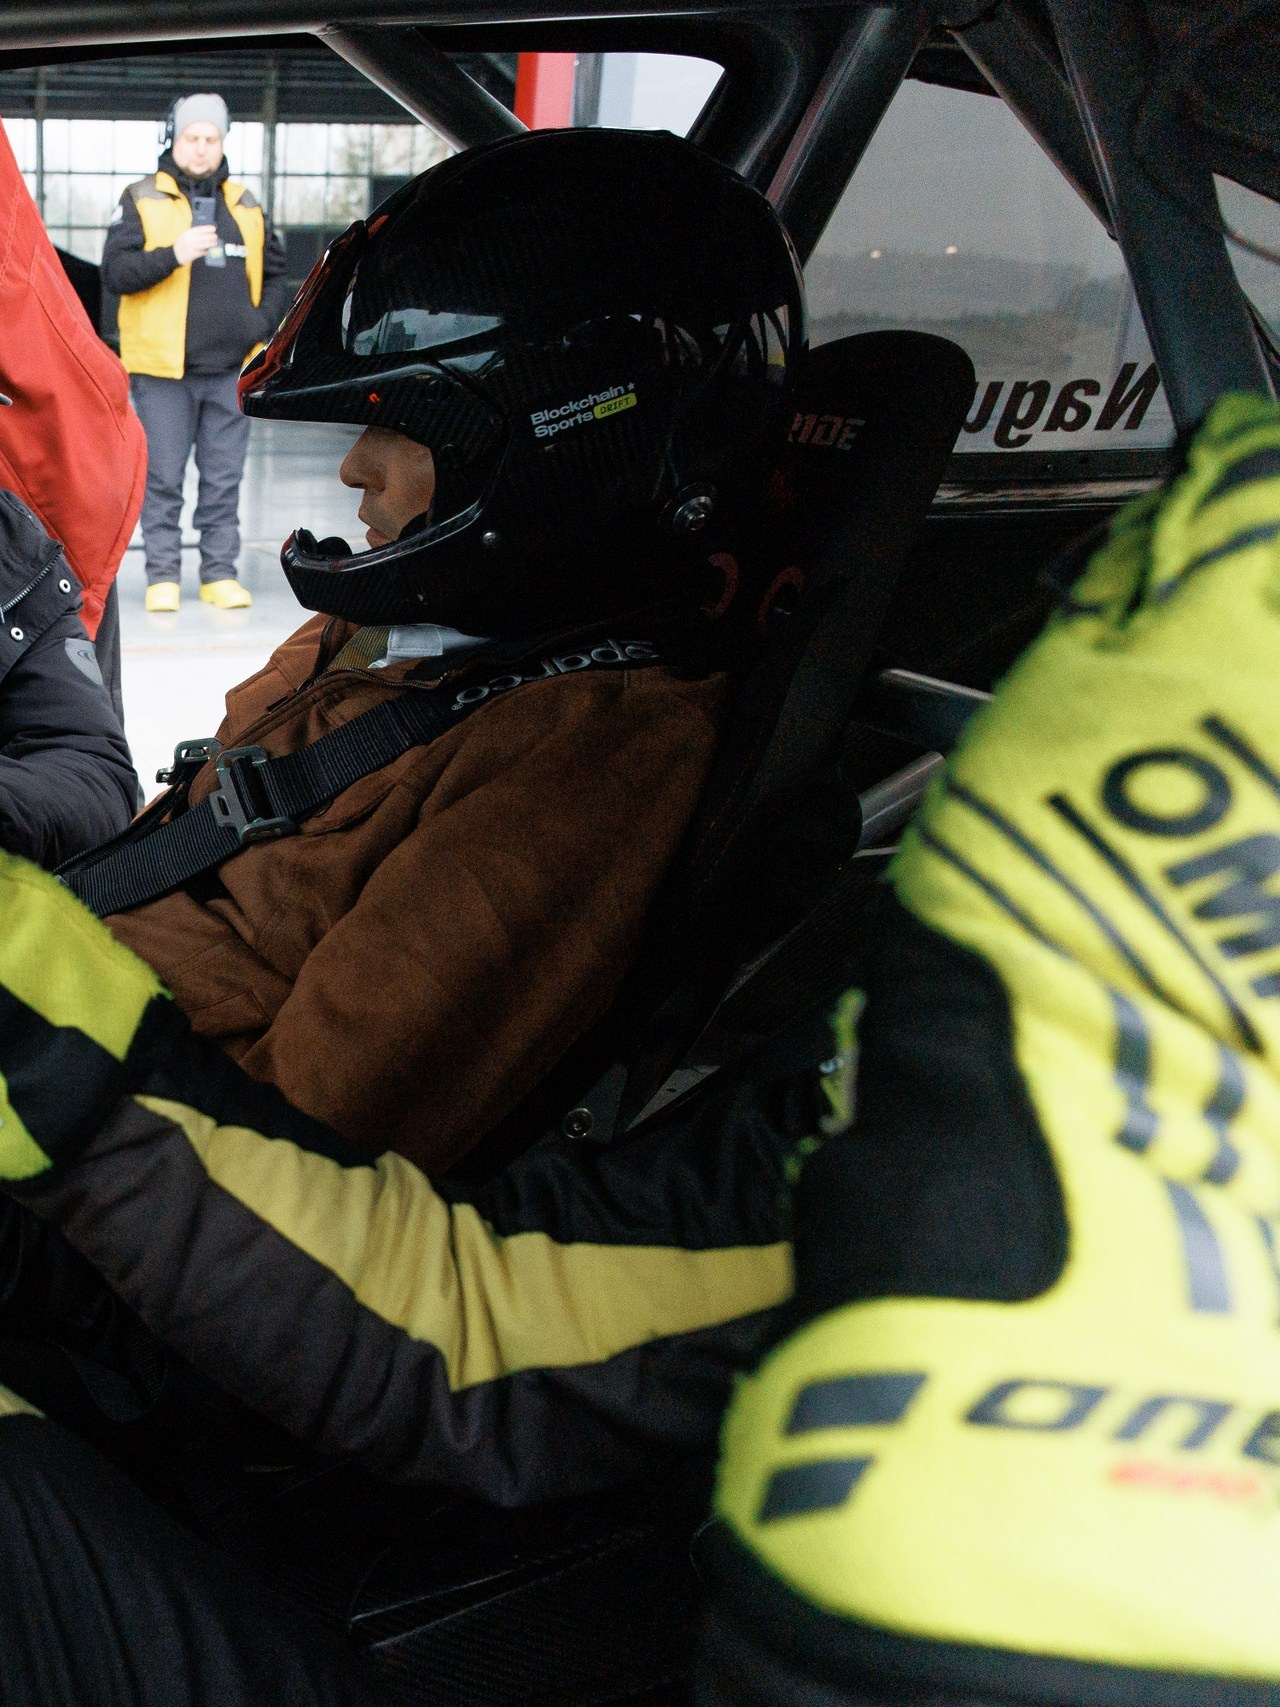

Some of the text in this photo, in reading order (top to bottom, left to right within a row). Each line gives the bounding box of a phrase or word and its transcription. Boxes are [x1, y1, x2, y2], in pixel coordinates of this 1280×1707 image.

[530, 385, 625, 426] Blockchain
[534, 397, 630, 438] Sports DRIFT
[1103, 744, 1280, 998] OM
